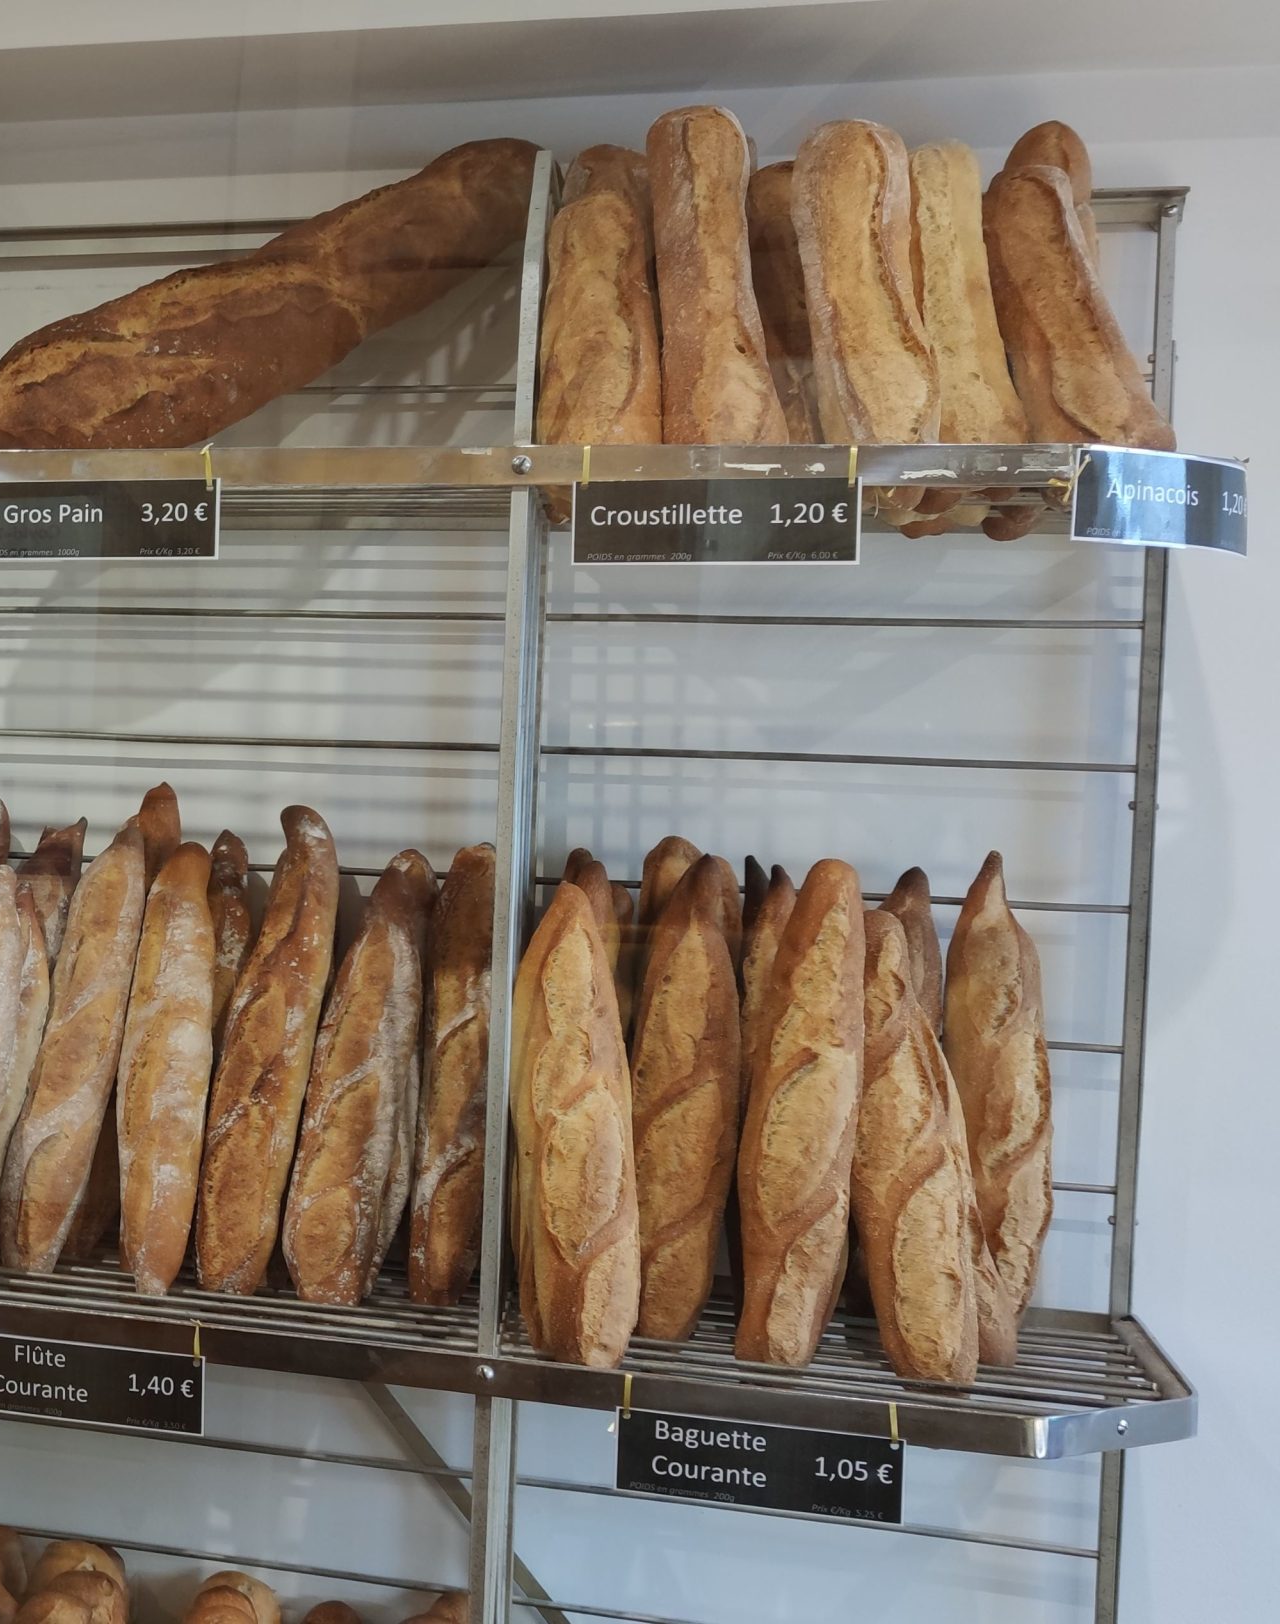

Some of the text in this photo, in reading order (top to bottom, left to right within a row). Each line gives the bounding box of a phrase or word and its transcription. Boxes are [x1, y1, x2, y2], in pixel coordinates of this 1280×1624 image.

[1106, 478, 1199, 507] Apinacois
[1222, 491, 1243, 517] 1,20
[3, 503, 208, 526] Gros Pain 3,20 €
[590, 502, 848, 528] Croustillette 1,20 €
[1086, 527, 1111, 536] POIDS
[20, 549, 54, 558] grammes
[57, 548, 81, 557] 1000g
[139, 547, 154, 555] Prix
[155, 547, 173, 556] €/Kg
[194, 547, 201, 555] €
[587, 552, 613, 561] POIDS
[626, 553, 666, 562] grammes
[670, 552, 692, 561] 200g
[767, 551, 784, 560] Prix
[785, 551, 807, 561] €/Kg
[832, 551, 839, 559] €
[14, 1344, 66, 1368] Flûte
[128, 1373, 174, 1397] 1,40
[180, 1379, 194, 1398] €
[655, 1420, 767, 1452] Baguette
[651, 1455, 893, 1488] Courante 1,05 €
[630, 1481, 655, 1491] POIDS
[669, 1487, 709, 1498] grammes
[713, 1491, 735, 1503] 200g
[811, 1504, 827, 1513] Prix
